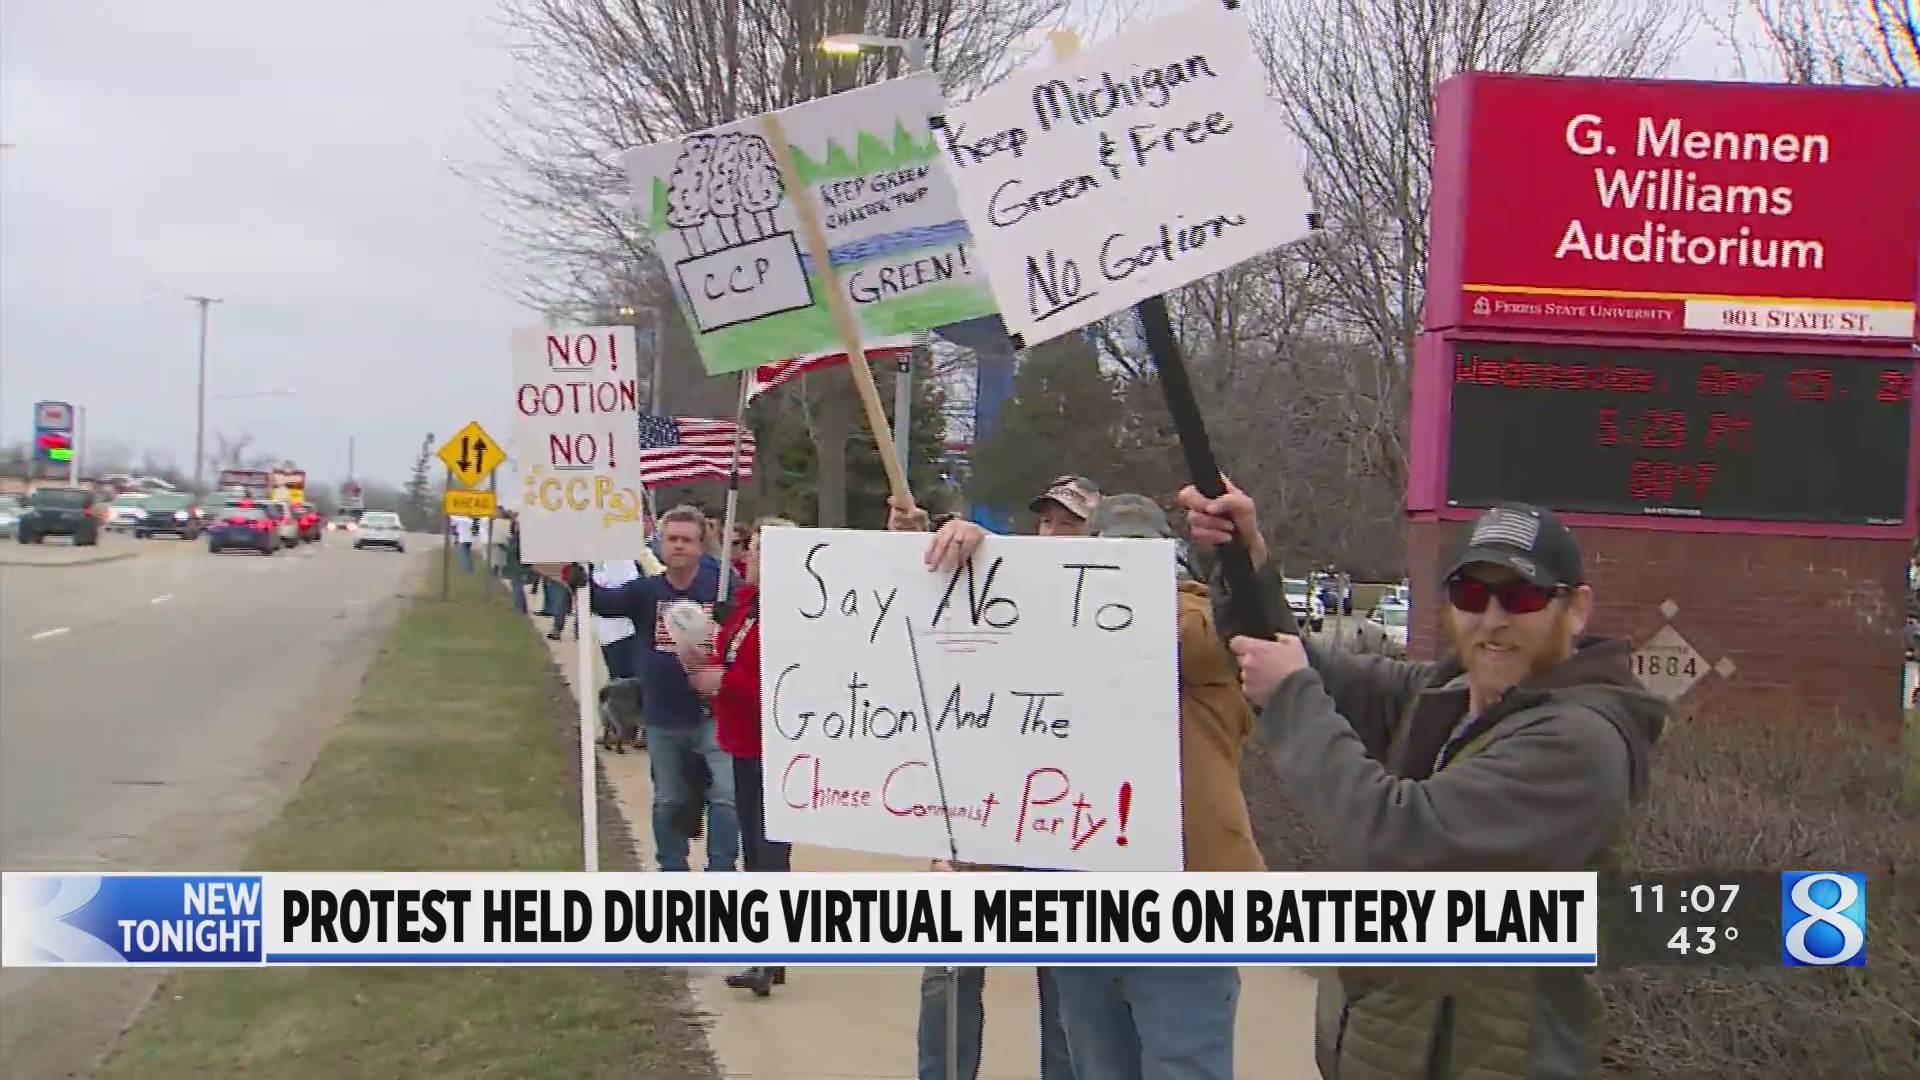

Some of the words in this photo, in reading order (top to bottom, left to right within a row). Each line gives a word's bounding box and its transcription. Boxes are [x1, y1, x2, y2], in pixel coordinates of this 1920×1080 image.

[945, 120, 1027, 167] Keep
[1032, 54, 1218, 131] Michigan
[1565, 113, 1616, 157] G.
[1637, 116, 1830, 163] Mennen
[820, 177, 866, 208] KEEP
[870, 164, 930, 193] GREEN
[987, 173, 1101, 227] Green
[1128, 111, 1235, 168] Free
[1595, 167, 1794, 216] Williams
[1026, 249, 1081, 315] No
[1099, 213, 1247, 281] Gotion
[1554, 219, 1825, 269] Auditorium
[703, 257, 770, 300] CCP
[850, 242, 971, 303] GREEN!
[1494, 301, 1542, 315] FERRIS
[1545, 303, 1587, 317] STATE
[1590, 305, 1673, 320] UNIVERSITY
[1723, 310, 1758, 327] 901
[1766, 310, 1835, 329] STATE
[1840, 311, 1874, 331] ST.
[517, 379, 637, 416] GOTION
[539, 476, 614, 512] CCP
[799, 543, 897, 643] Say
[932, 557, 1020, 628] No
[1062, 564, 1134, 631] To
[773, 663, 917, 741] Gotion
[936, 682, 994, 731] And
[1010, 690, 1071, 739] The
[781, 754, 871, 811] Chinese
